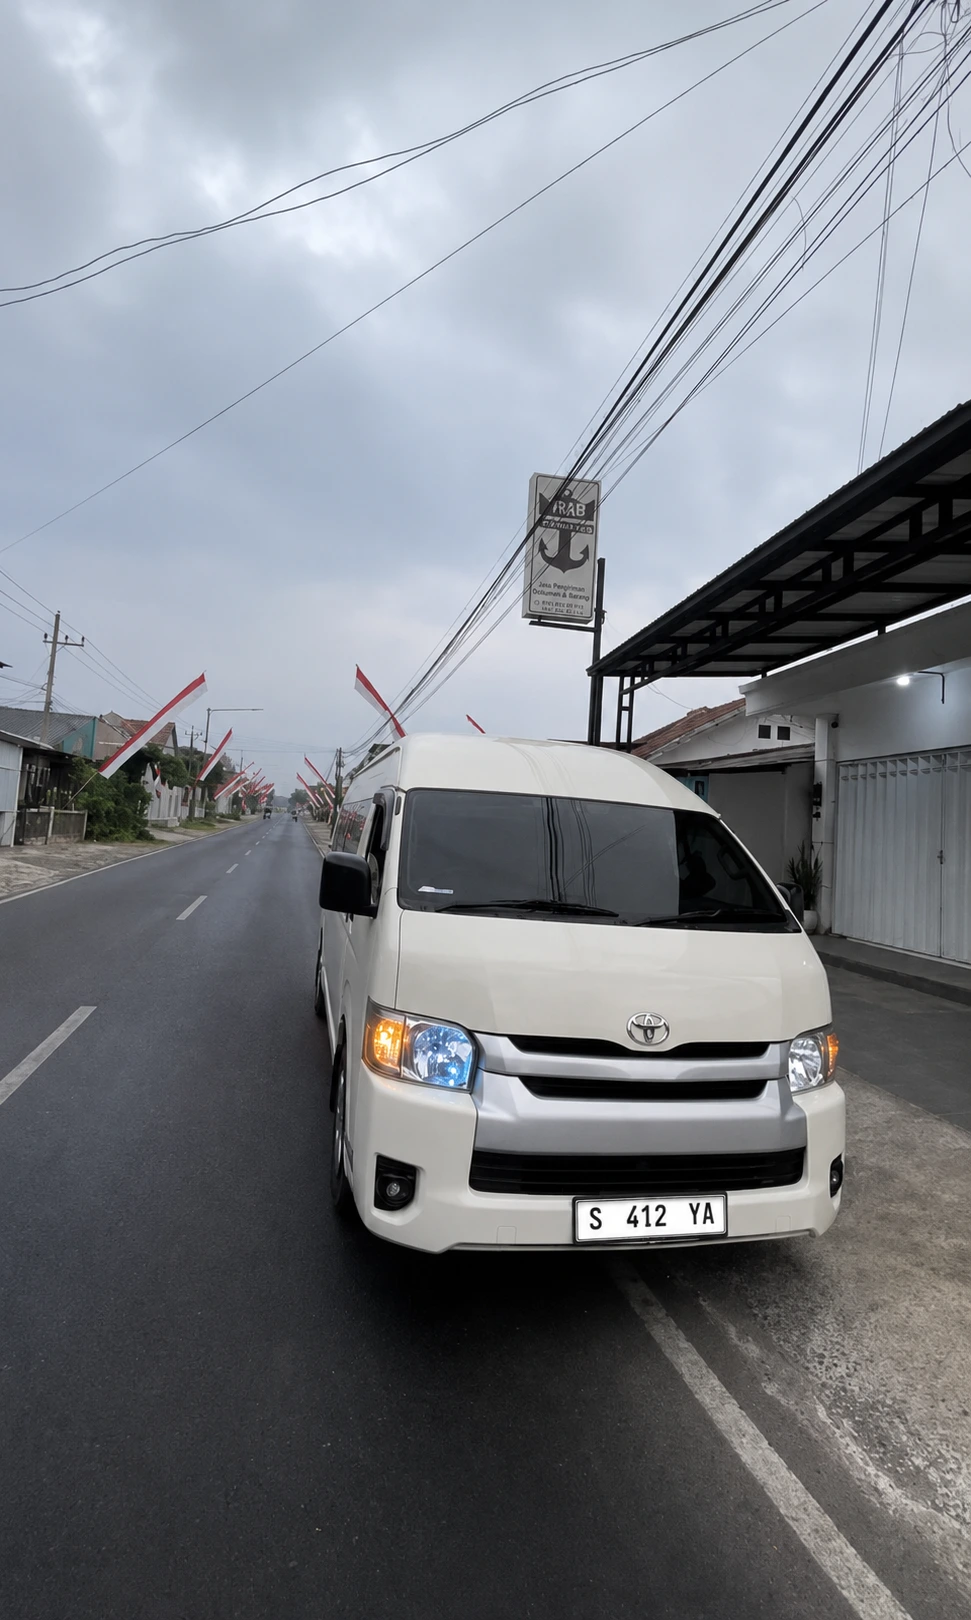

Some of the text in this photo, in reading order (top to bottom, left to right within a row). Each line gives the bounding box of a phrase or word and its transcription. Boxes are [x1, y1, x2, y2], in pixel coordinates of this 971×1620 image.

[589, 1202, 714, 1230] S 412 YA
